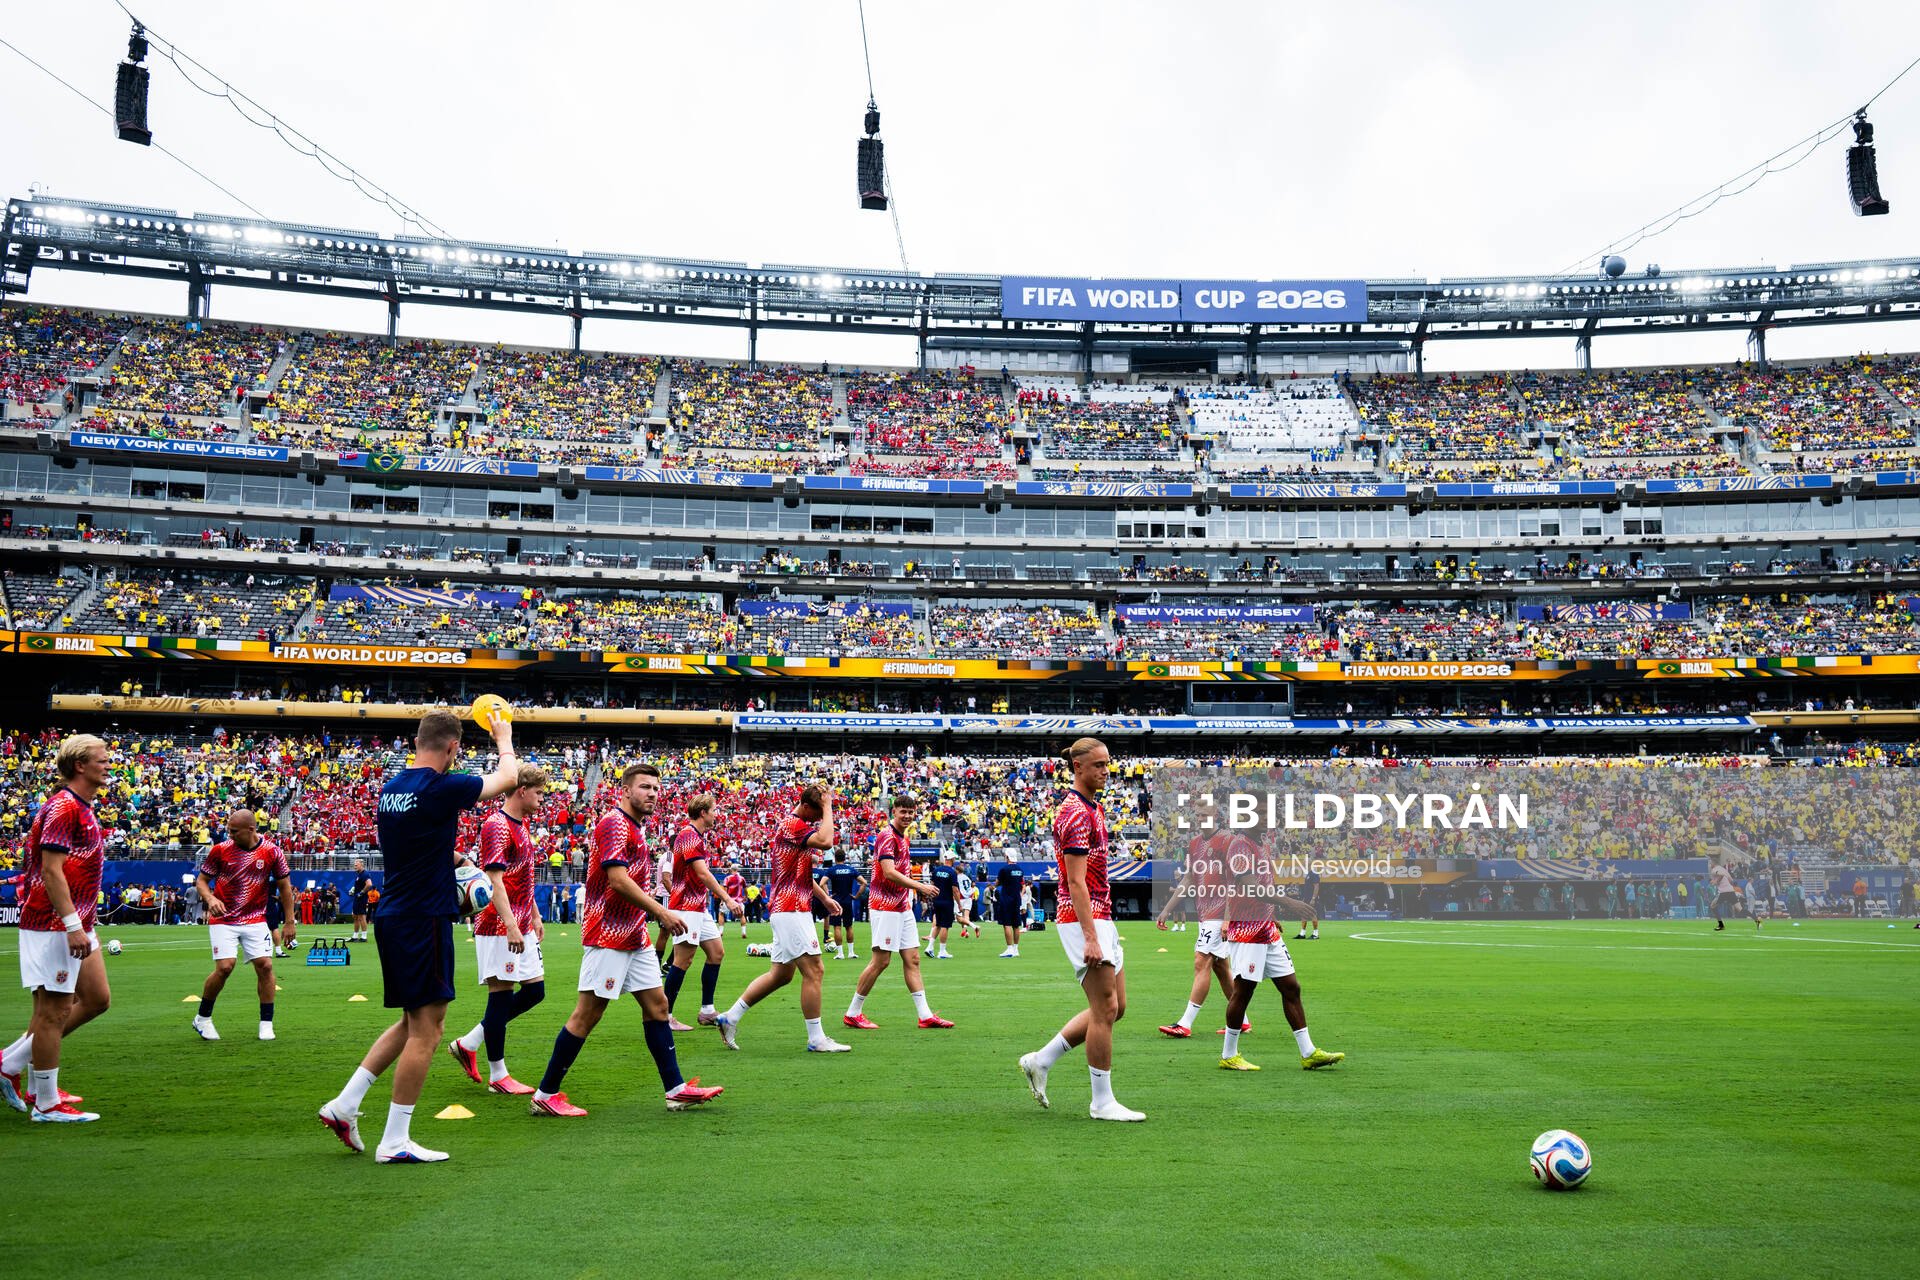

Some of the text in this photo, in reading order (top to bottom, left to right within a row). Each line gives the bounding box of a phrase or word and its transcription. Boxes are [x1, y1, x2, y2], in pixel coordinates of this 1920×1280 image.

[1022, 287, 1347, 310] FIFA WORLD CUP 2026
[80, 435, 279, 458] NEW YORK NEW JERSEY
[862, 478, 929, 491] #FIFAWorldCup
[1493, 482, 1560, 494] #FIFAWorldCup
[1126, 608, 1302, 617] NEW YORK NEW JERSEY
[55, 637, 96, 651] BRAZIL
[273, 646, 467, 664] FIFA WORLD CUP 2026
[648, 657, 683, 670] BRAZIL
[883, 662, 956, 676] #FIFAWorldCup
[1680, 662, 1714, 674] BRAZIL
[1169, 665, 1201, 676] BRAZIL
[1344, 664, 1512, 677] FIFA WORLD CUP 2026
[784, 717, 843, 725] WORLD
[1196, 720, 1295, 729] #FIFAWorldCup
[1552, 719, 1587, 727] FIFA
[1368, 865, 1423, 878] 2026
[264, 933, 271, 946] 4
